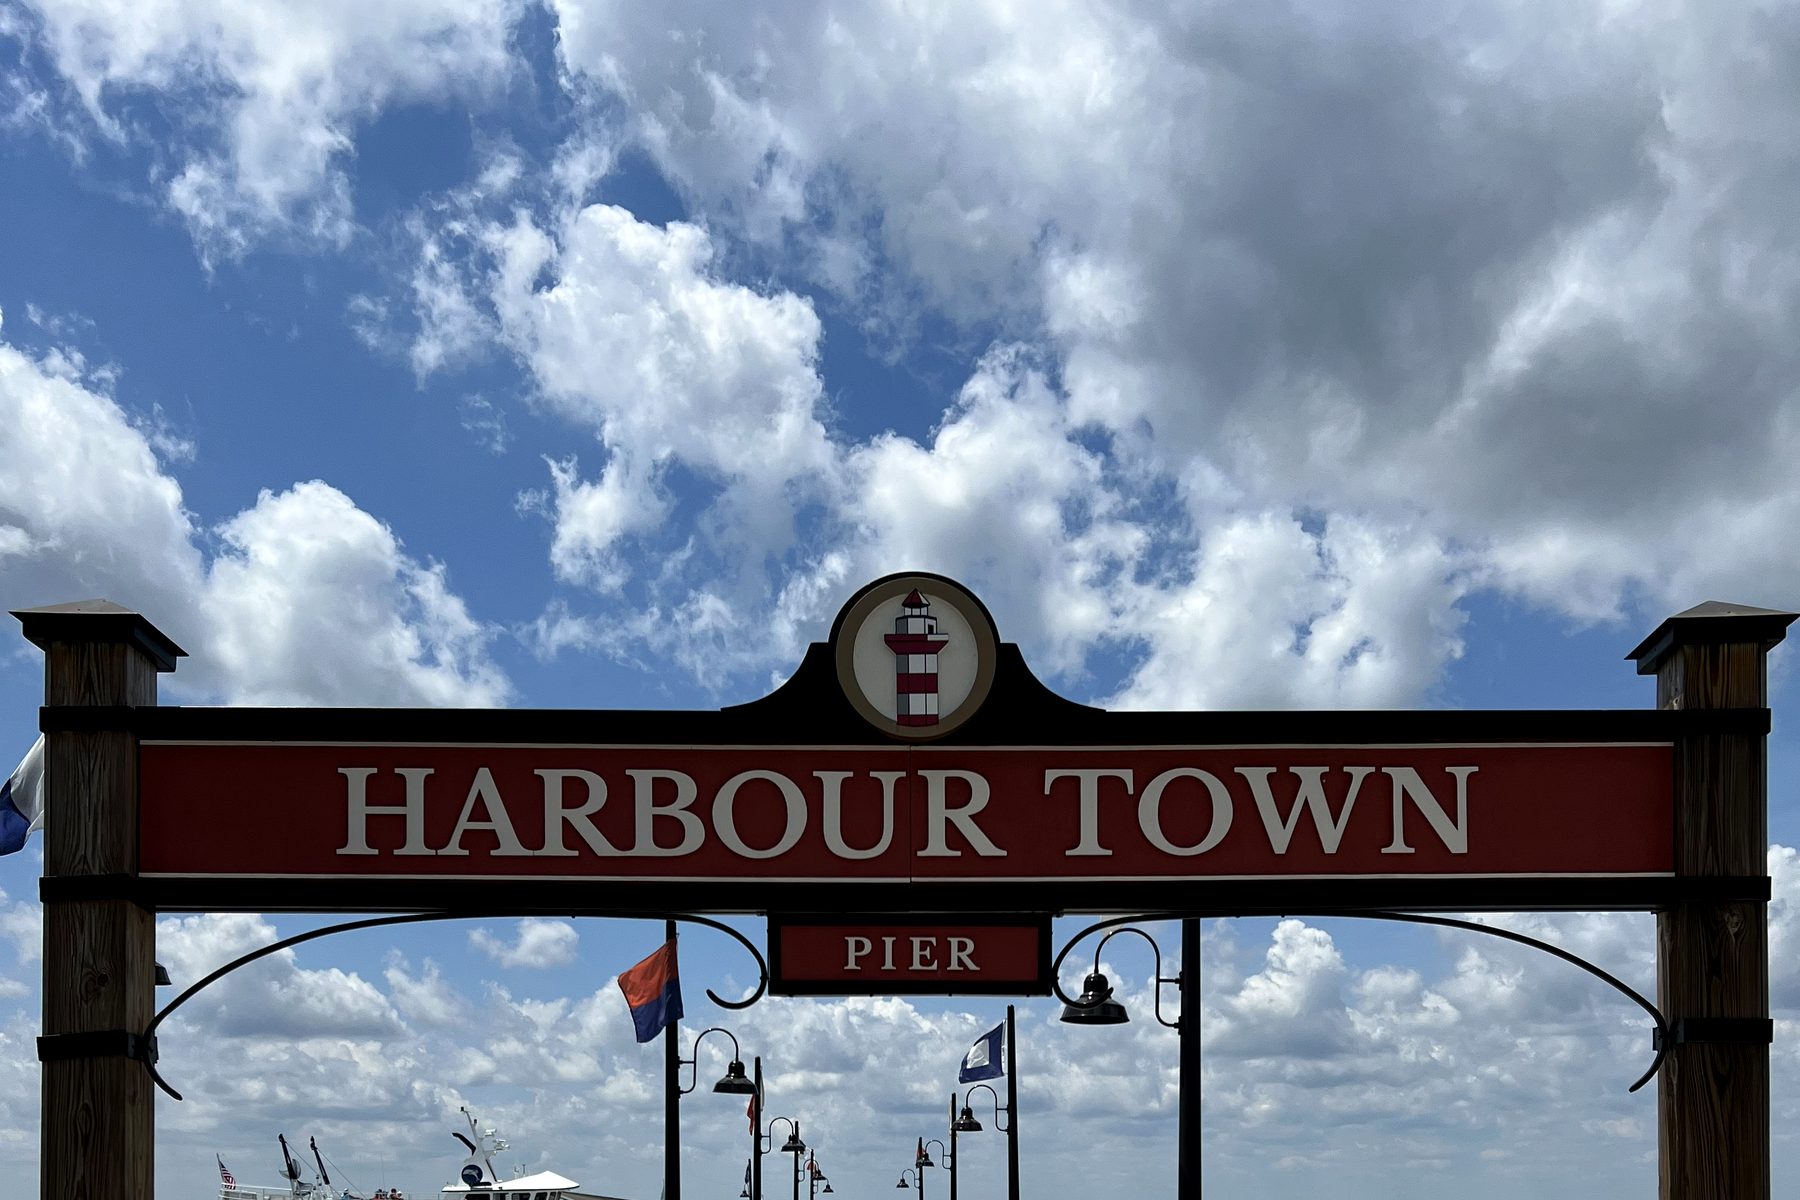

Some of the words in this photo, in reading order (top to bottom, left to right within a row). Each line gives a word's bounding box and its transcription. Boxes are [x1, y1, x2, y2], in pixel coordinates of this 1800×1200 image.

[336, 767, 1008, 859] HARBOUR
[1044, 766, 1479, 856] TOWN
[844, 936, 980, 971] PIER
